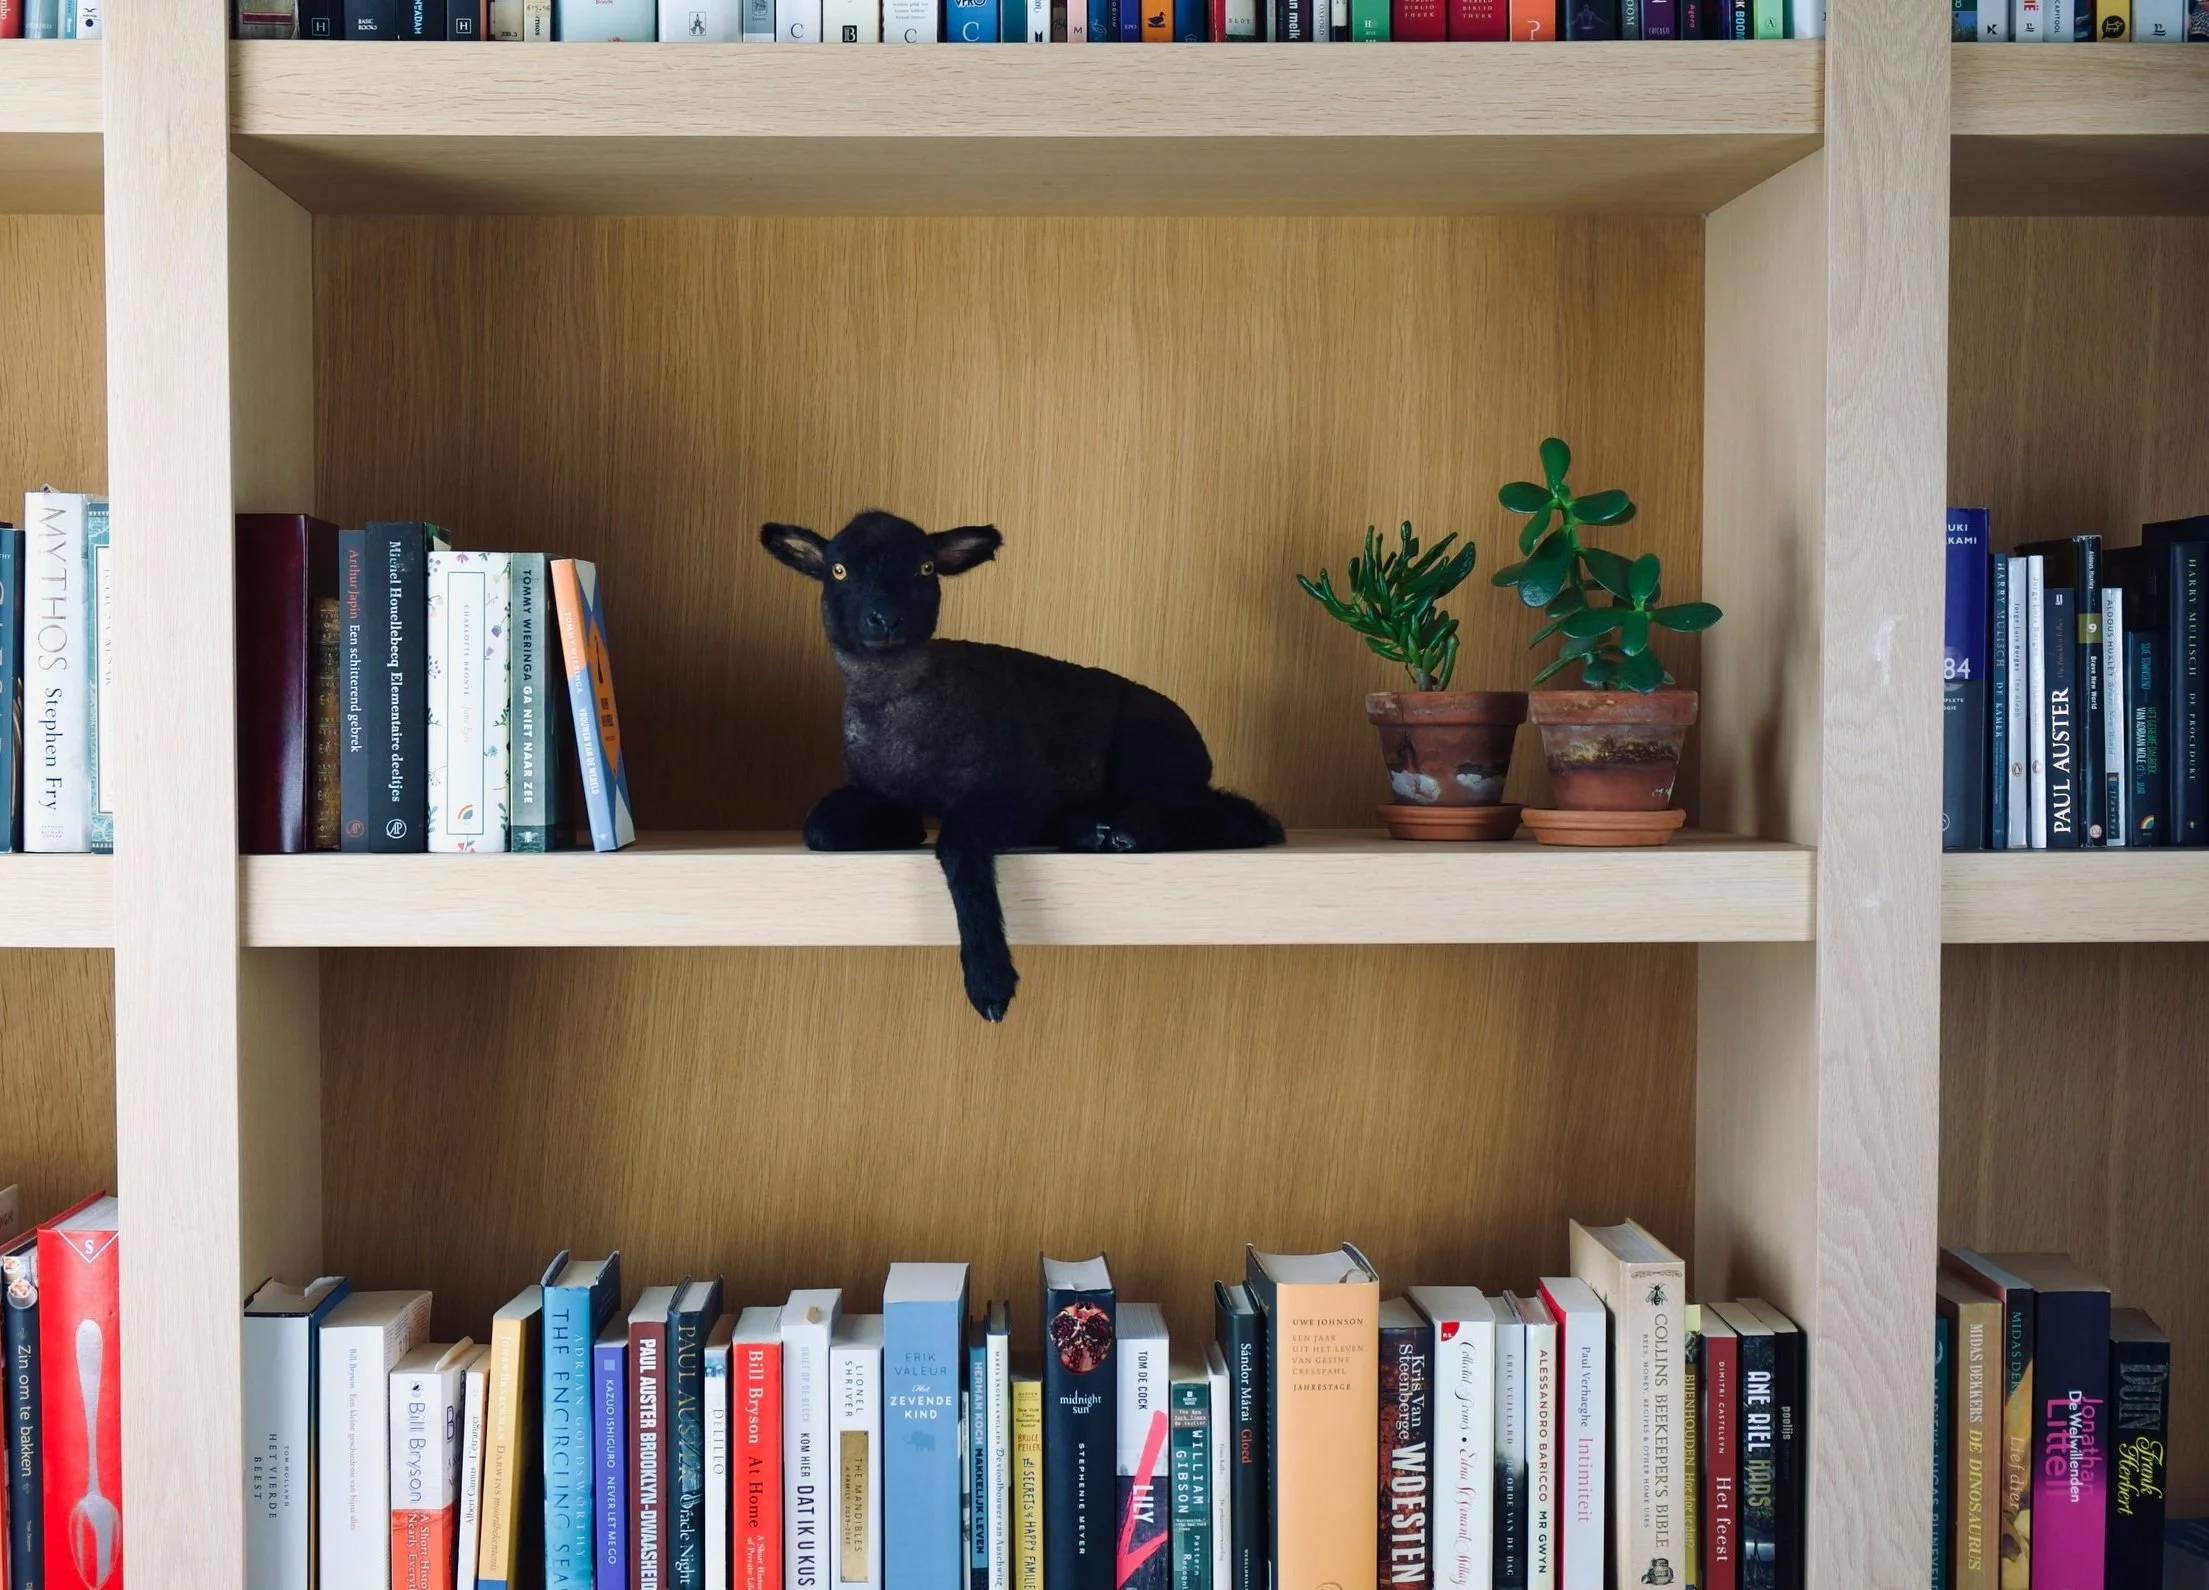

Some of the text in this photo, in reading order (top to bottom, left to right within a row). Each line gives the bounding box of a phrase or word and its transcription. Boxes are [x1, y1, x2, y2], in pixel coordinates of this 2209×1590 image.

[357, 24, 378, 32] BOOKS
[790, 23, 804, 39] C
[904, 29, 917, 43] C
[962, 22, 980, 42] C
[1687, 4, 1696, 28] Agora
[2053, 0, 2061, 34] CAPITOOL
[37, 507, 69, 672] MYTHOS
[2086, 550, 2096, 590] Aldous Huxley
[2012, 603, 2021, 624] Jorge
[346, 549, 362, 752] Arthur Japin Een schitterend gebrek
[386, 540, 403, 803] Michel Houellebecq Elementaire deeltjes
[1943, 657, 1970, 680] 84
[1996, 563, 2005, 738] HARRY MULISCH DE KAMER
[2012, 645, 2021, 672] Borges
[2188, 559, 2197, 781] HARRY MULISCH DE PROCEDURE
[522, 569, 533, 804] TOMMY WIERINGA GA NIET NAAR ZEE
[2013, 695, 2022, 718] Aleph
[2014, 678, 2022, 691] The
[2090, 655, 2099, 710] Brave New World
[37, 687, 63, 768] Stephen
[2051, 686, 2070, 775] AUSTER
[38, 777, 63, 812] Fry
[2053, 779, 2071, 834] PAUL
[551, 1308, 570, 1355] THE
[1292, 1334, 1337, 1343] EEN JAAR
[1292, 1345, 1364, 1353] UIT HET LEVEN
[1316, 1318, 1364, 1328] JOHNSON
[638, 1338, 657, 1373] PAUL
[895, 1366, 948, 1376] VALEUR
[905, 1352, 936, 1362] ERIK
[1137, 1350, 1149, 1411] TOM DE COCK
[1292, 1368, 1347, 1376] CRESSPAHL
[17, 1344, 34, 1477] Zin om te bakken
[638, 1376, 657, 1428] AUSTER
[844, 1359, 853, 1418] SHRIVER
[855, 1364, 864, 1413] LIONEL
[889, 1396, 953, 1406] ZEVENDE
[904, 1409, 938, 1420] KIND
[911, 1383, 929, 1393] Het
[1059, 1389, 1101, 1408] midnight
[1072, 1405, 1090, 1414] sun
[1239, 1342, 1253, 1465] Sándor Márai Gloed
[1292, 1384, 1351, 1392] JAHRESTAGE
[1395, 1343, 1413, 1440] Steenberge
[1410, 1353, 1426, 1428] Kris Van
[2117, 1361, 2169, 1432] DUIN
[551, 1371, 570, 1531] ENCIRCLING
[574, 1334, 585, 1557] ADRIAN GOLDSWORTHY
[744, 1349, 764, 1528] Bill Bryson At Home
[1017, 1434, 1039, 1442] BRUCE
[1577, 1346, 1594, 1523] Paul Verhaeghe Intimiteit
[1653, 1313, 1669, 1548] COLLINS BEEKEEPER'S BIBLE
[1746, 1371, 1771, 1507] ANE RIEL HARS
[1781, 1405, 1793, 1440] poolijs
[1967, 1323, 1984, 1571] MIDAS DEKKERS DE DINOSAURUS
[2045, 1398, 2079, 1497] Littell
[2067, 1390, 2084, 1503] De Welwillenden
[2080, 1395, 2104, 1498] Jonathan
[253, 1456, 262, 1501] BEEST
[268, 1433, 278, 1520] HET VIERDE
[407, 1402, 427, 1503] Bill Bryson
[605, 1379, 617, 1565] KAZUO ISHIGURO NEVER LET ME GO
[675, 1325, 700, 1584] PAUL AUSTER Oracle Night
[974, 1362, 985, 1554] HERMAN KOCH MAKKELIJK LEVEN
[1176, 1450, 1188, 1513] GIBSON
[1192, 1429, 1204, 1505] WILLIAM
[1538, 1349, 1549, 1574] ALESSANDRO BARICCO MR GWYN
[2116, 1443, 2140, 1516] Herbert
[2136, 1436, 2164, 1500] Frank
[853, 1457, 863, 1553] THE MANDIBLES
[1078, 1442, 1086, 1555] STEPHENIE MEYER
[1132, 1484, 1154, 1524] LILY
[1390, 1441, 1426, 1584] WOESTEN
[1715, 1476, 1732, 1510] Het
[1716, 1516, 1732, 1562] feest
